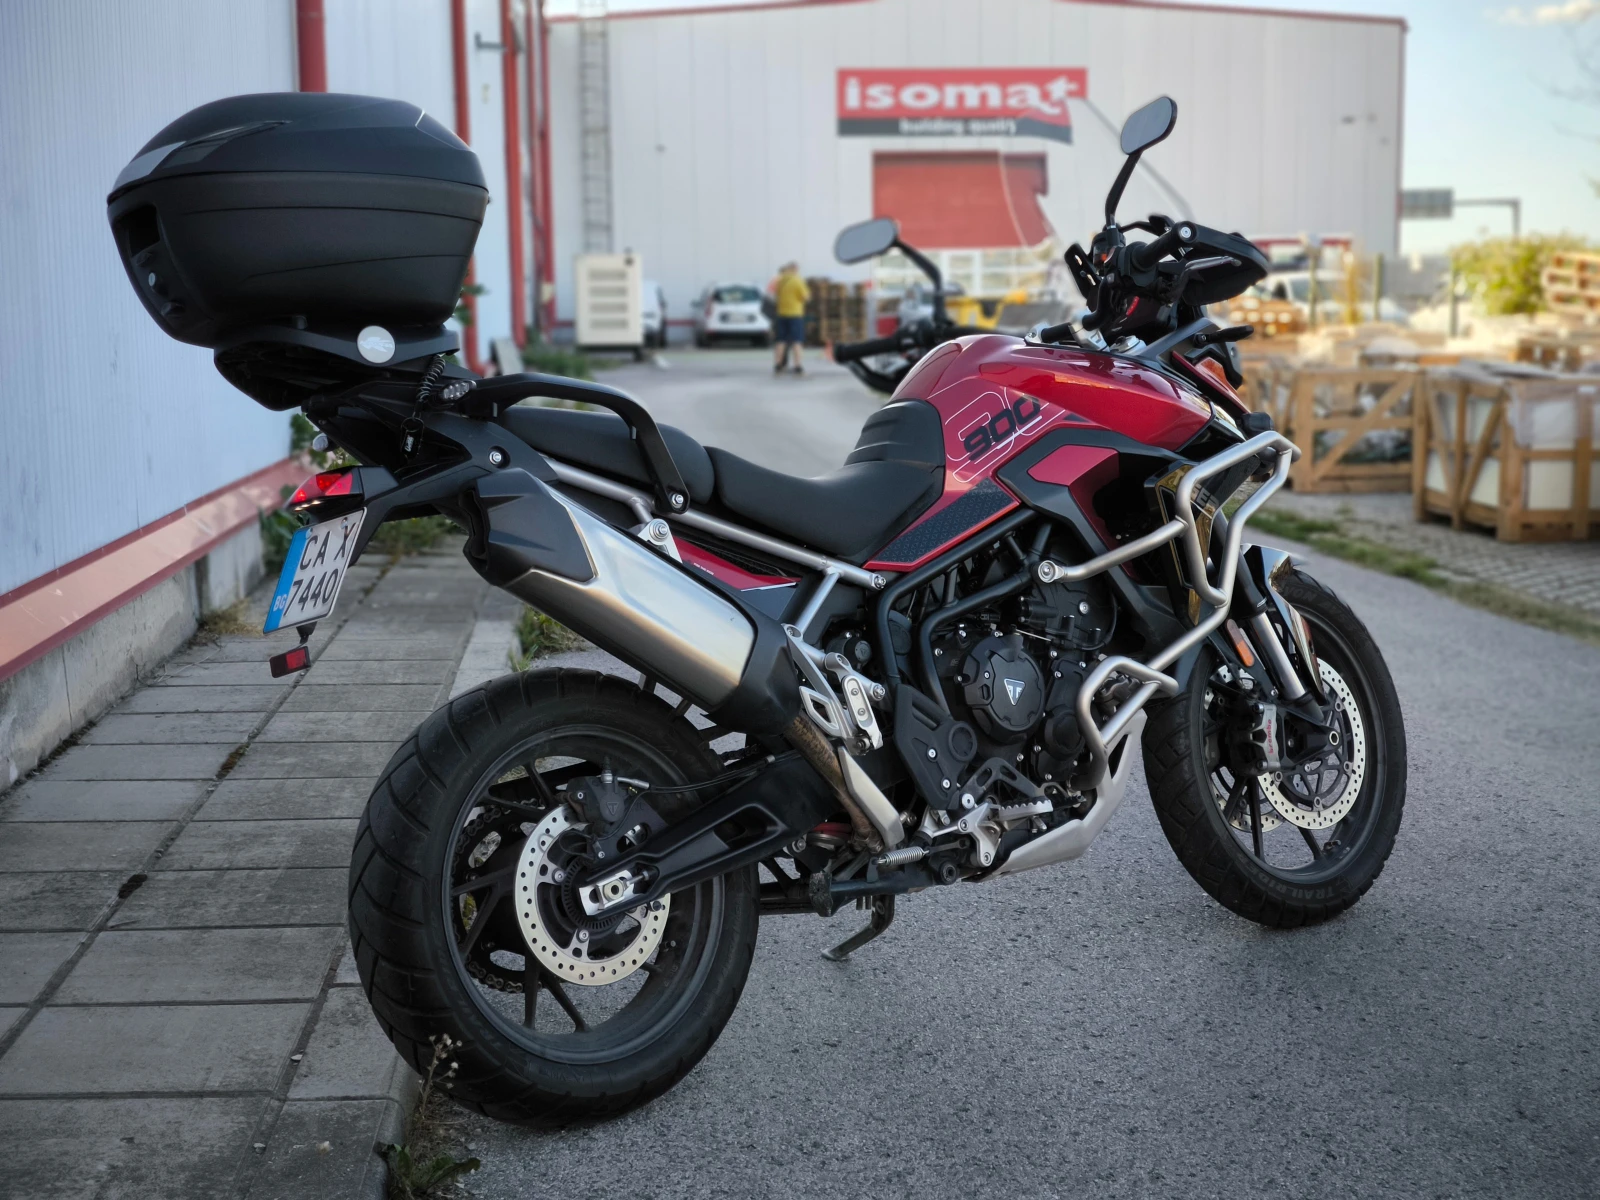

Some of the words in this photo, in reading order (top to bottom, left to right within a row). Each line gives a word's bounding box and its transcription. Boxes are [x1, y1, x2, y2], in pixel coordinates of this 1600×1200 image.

[844, 76, 1078, 115] isomat
[964, 396, 1041, 461] 900
[300, 530, 331, 571] CA
[334, 522, 356, 561] X
[273, 593, 288, 612] BG
[283, 568, 339, 617] 7440
[1266, 719, 1274, 755] brembo
